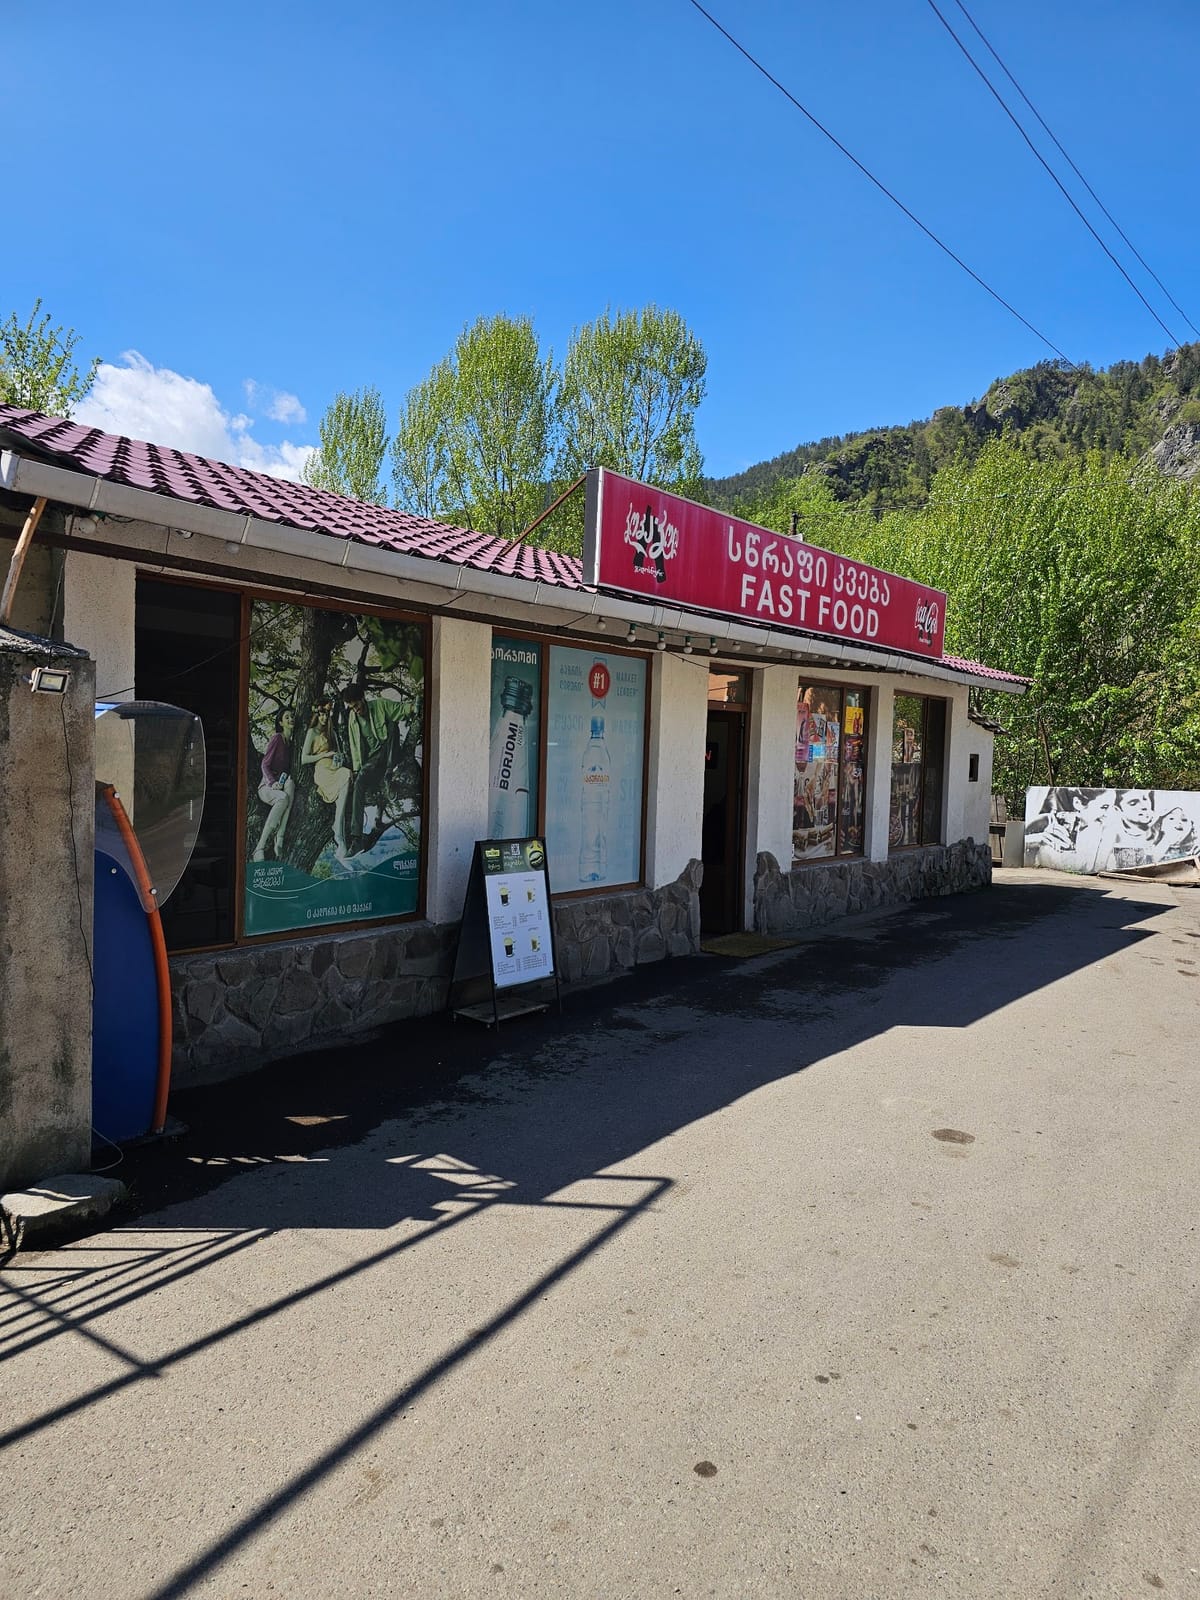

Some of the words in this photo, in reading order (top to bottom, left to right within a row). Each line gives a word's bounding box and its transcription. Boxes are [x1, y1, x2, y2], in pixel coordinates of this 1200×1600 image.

[728, 526, 827, 588] სწრაფი
[834, 561, 891, 607] კვება
[741, 574, 811, 622] FAST
[818, 596, 879, 638] FOOD
[593, 672, 605, 690] #1
[499, 721, 519, 791] BORJOMI
